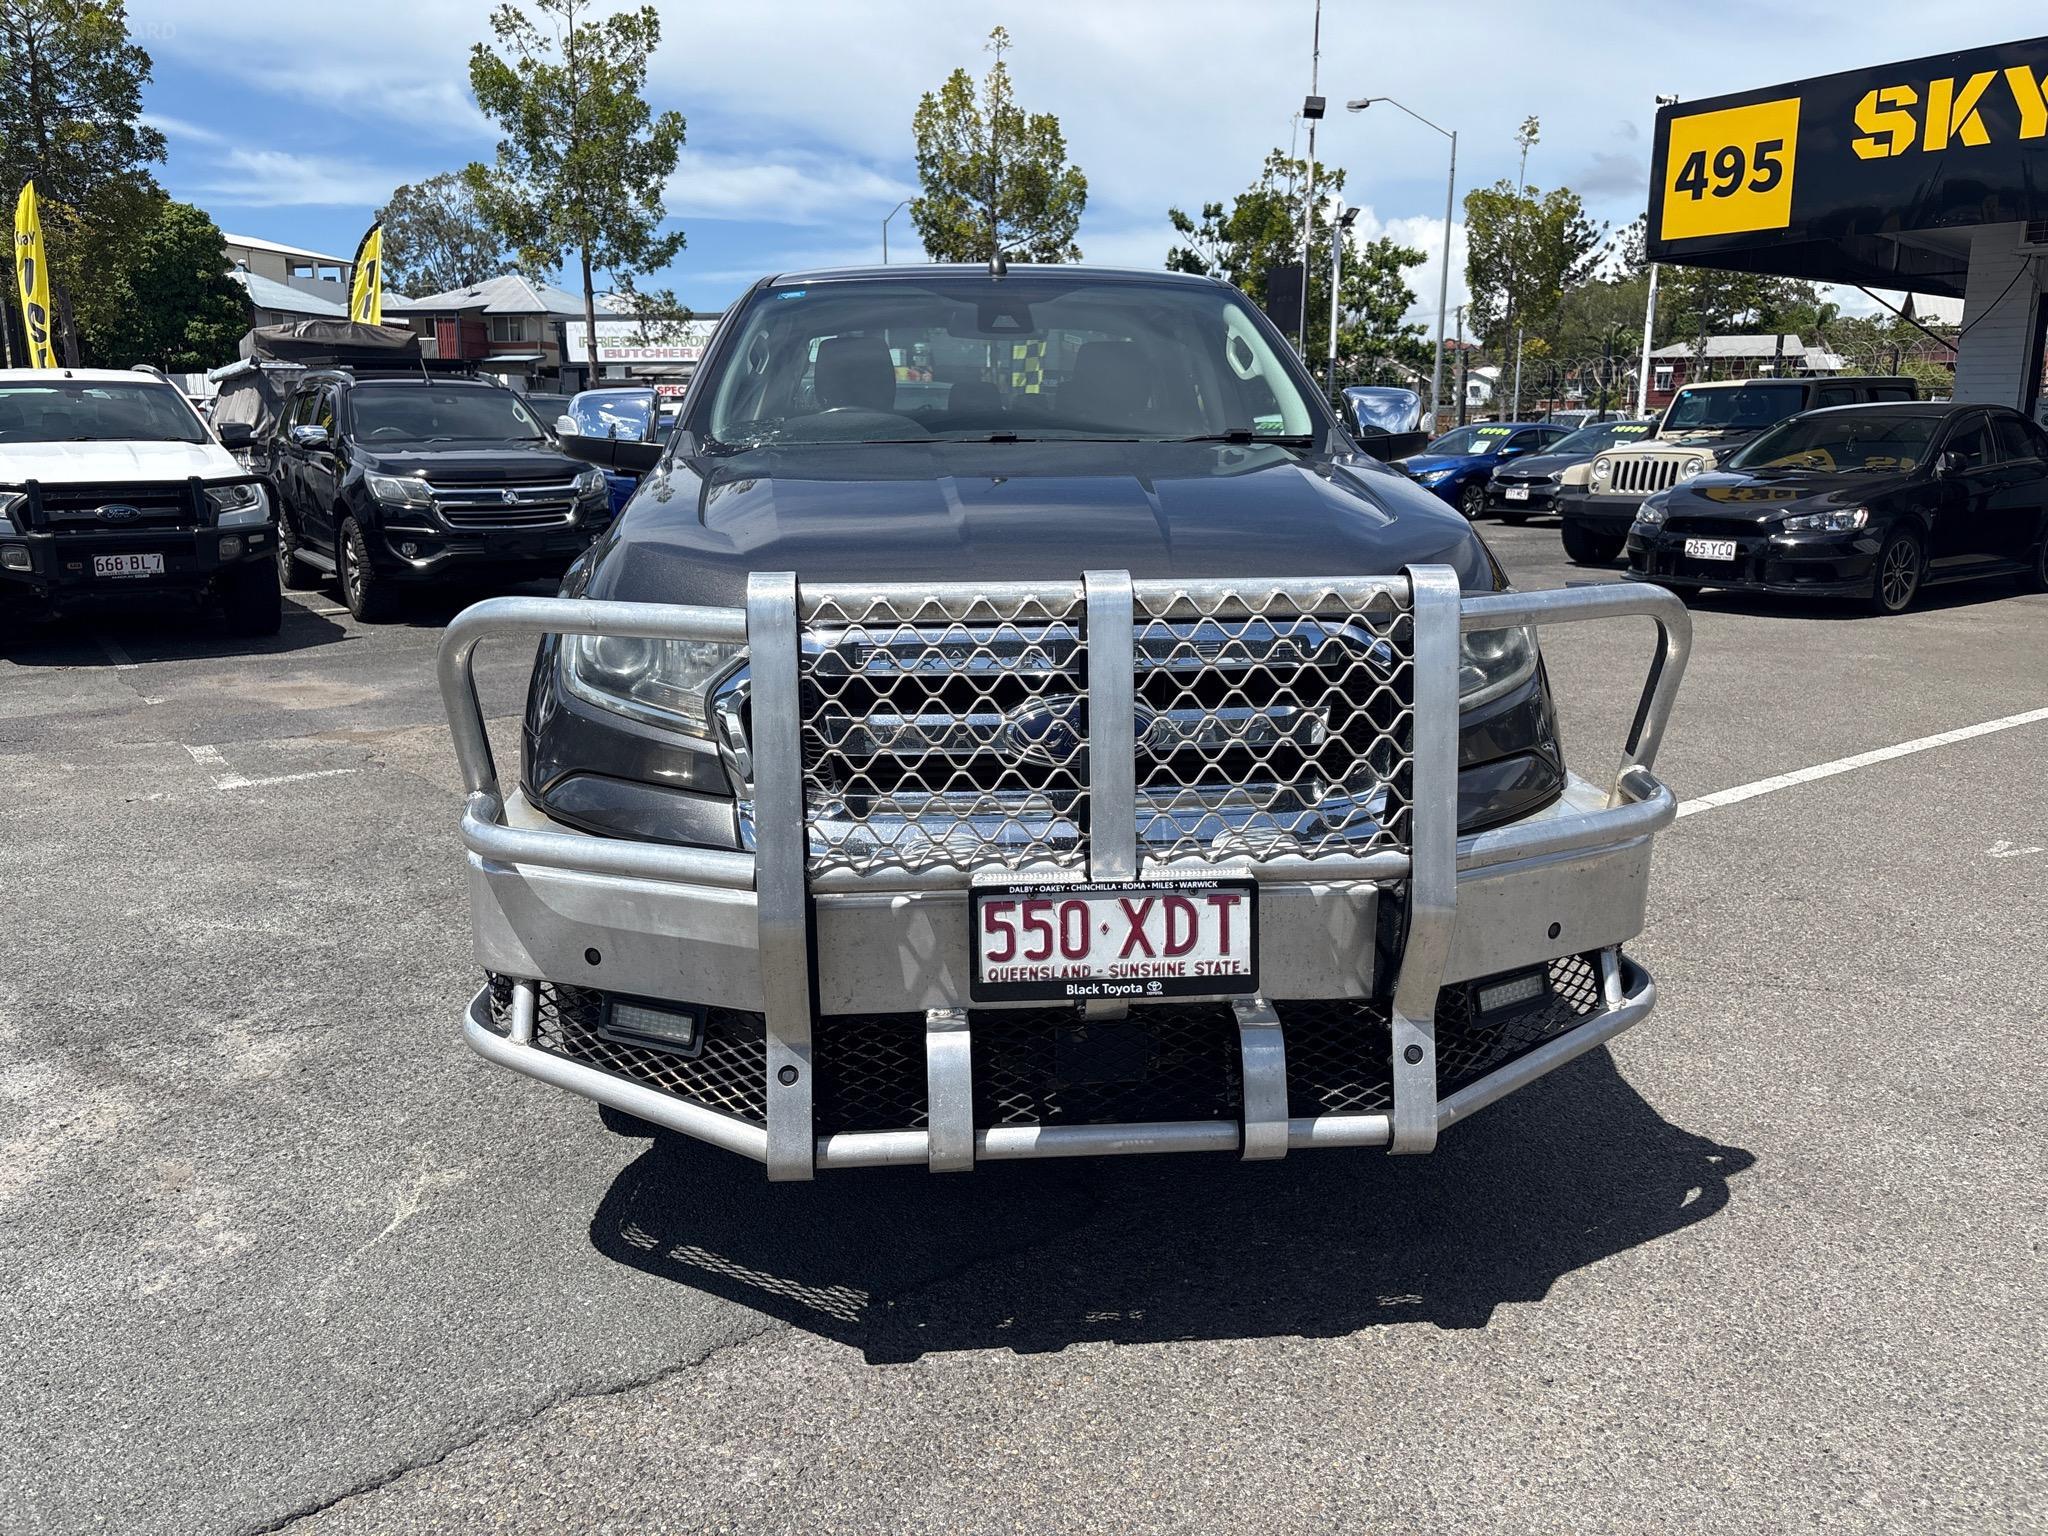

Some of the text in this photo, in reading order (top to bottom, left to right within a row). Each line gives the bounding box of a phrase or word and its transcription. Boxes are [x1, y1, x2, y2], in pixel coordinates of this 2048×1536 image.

[1674, 139, 1784, 201] 495
[604, 349, 693, 358] BUTCHER
[1009, 885, 1034, 894] DALBY
[1039, 884, 1065, 893] OAKEY
[1071, 883, 1117, 892] CHINCHILLA
[1151, 881, 1174, 889] MILES
[1179, 880, 1218, 888] WARWICK
[988, 960, 1241, 982] QUEENSLAND SUNSHINE STATE
[1066, 982, 1143, 996] Black Toyota
